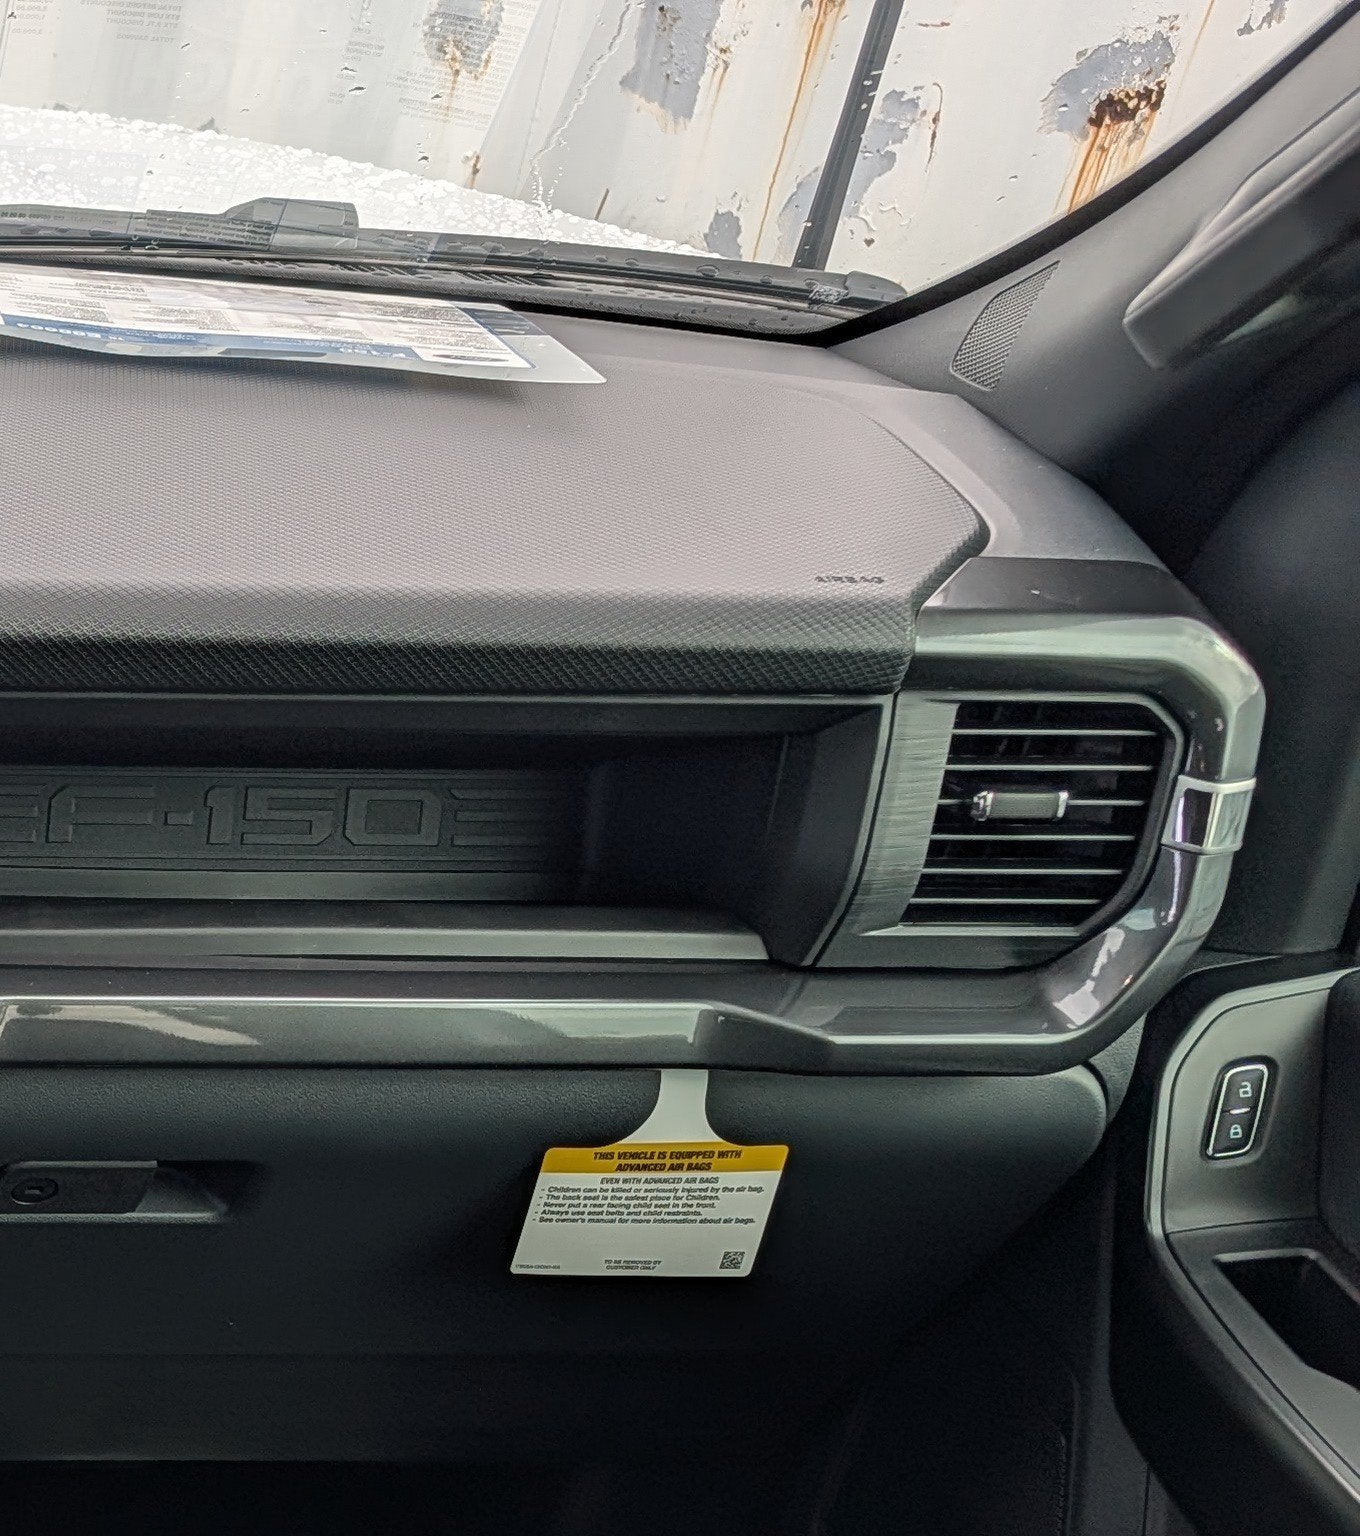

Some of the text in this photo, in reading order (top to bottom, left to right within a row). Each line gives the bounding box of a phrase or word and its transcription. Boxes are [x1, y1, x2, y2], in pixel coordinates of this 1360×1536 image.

[46, 783, 442, 847] F-150
[593, 1150, 742, 1161] THIS VEHICLE IS EQUIPPED WITH
[615, 1162, 713, 1172] ADVANCED AIR BAGS
[600, 1177, 621, 1185] EVEN
[622, 1177, 642, 1185] WITH
[643, 1177, 683, 1185] ADVANCED
[698, 1176, 720, 1184] BAGS
